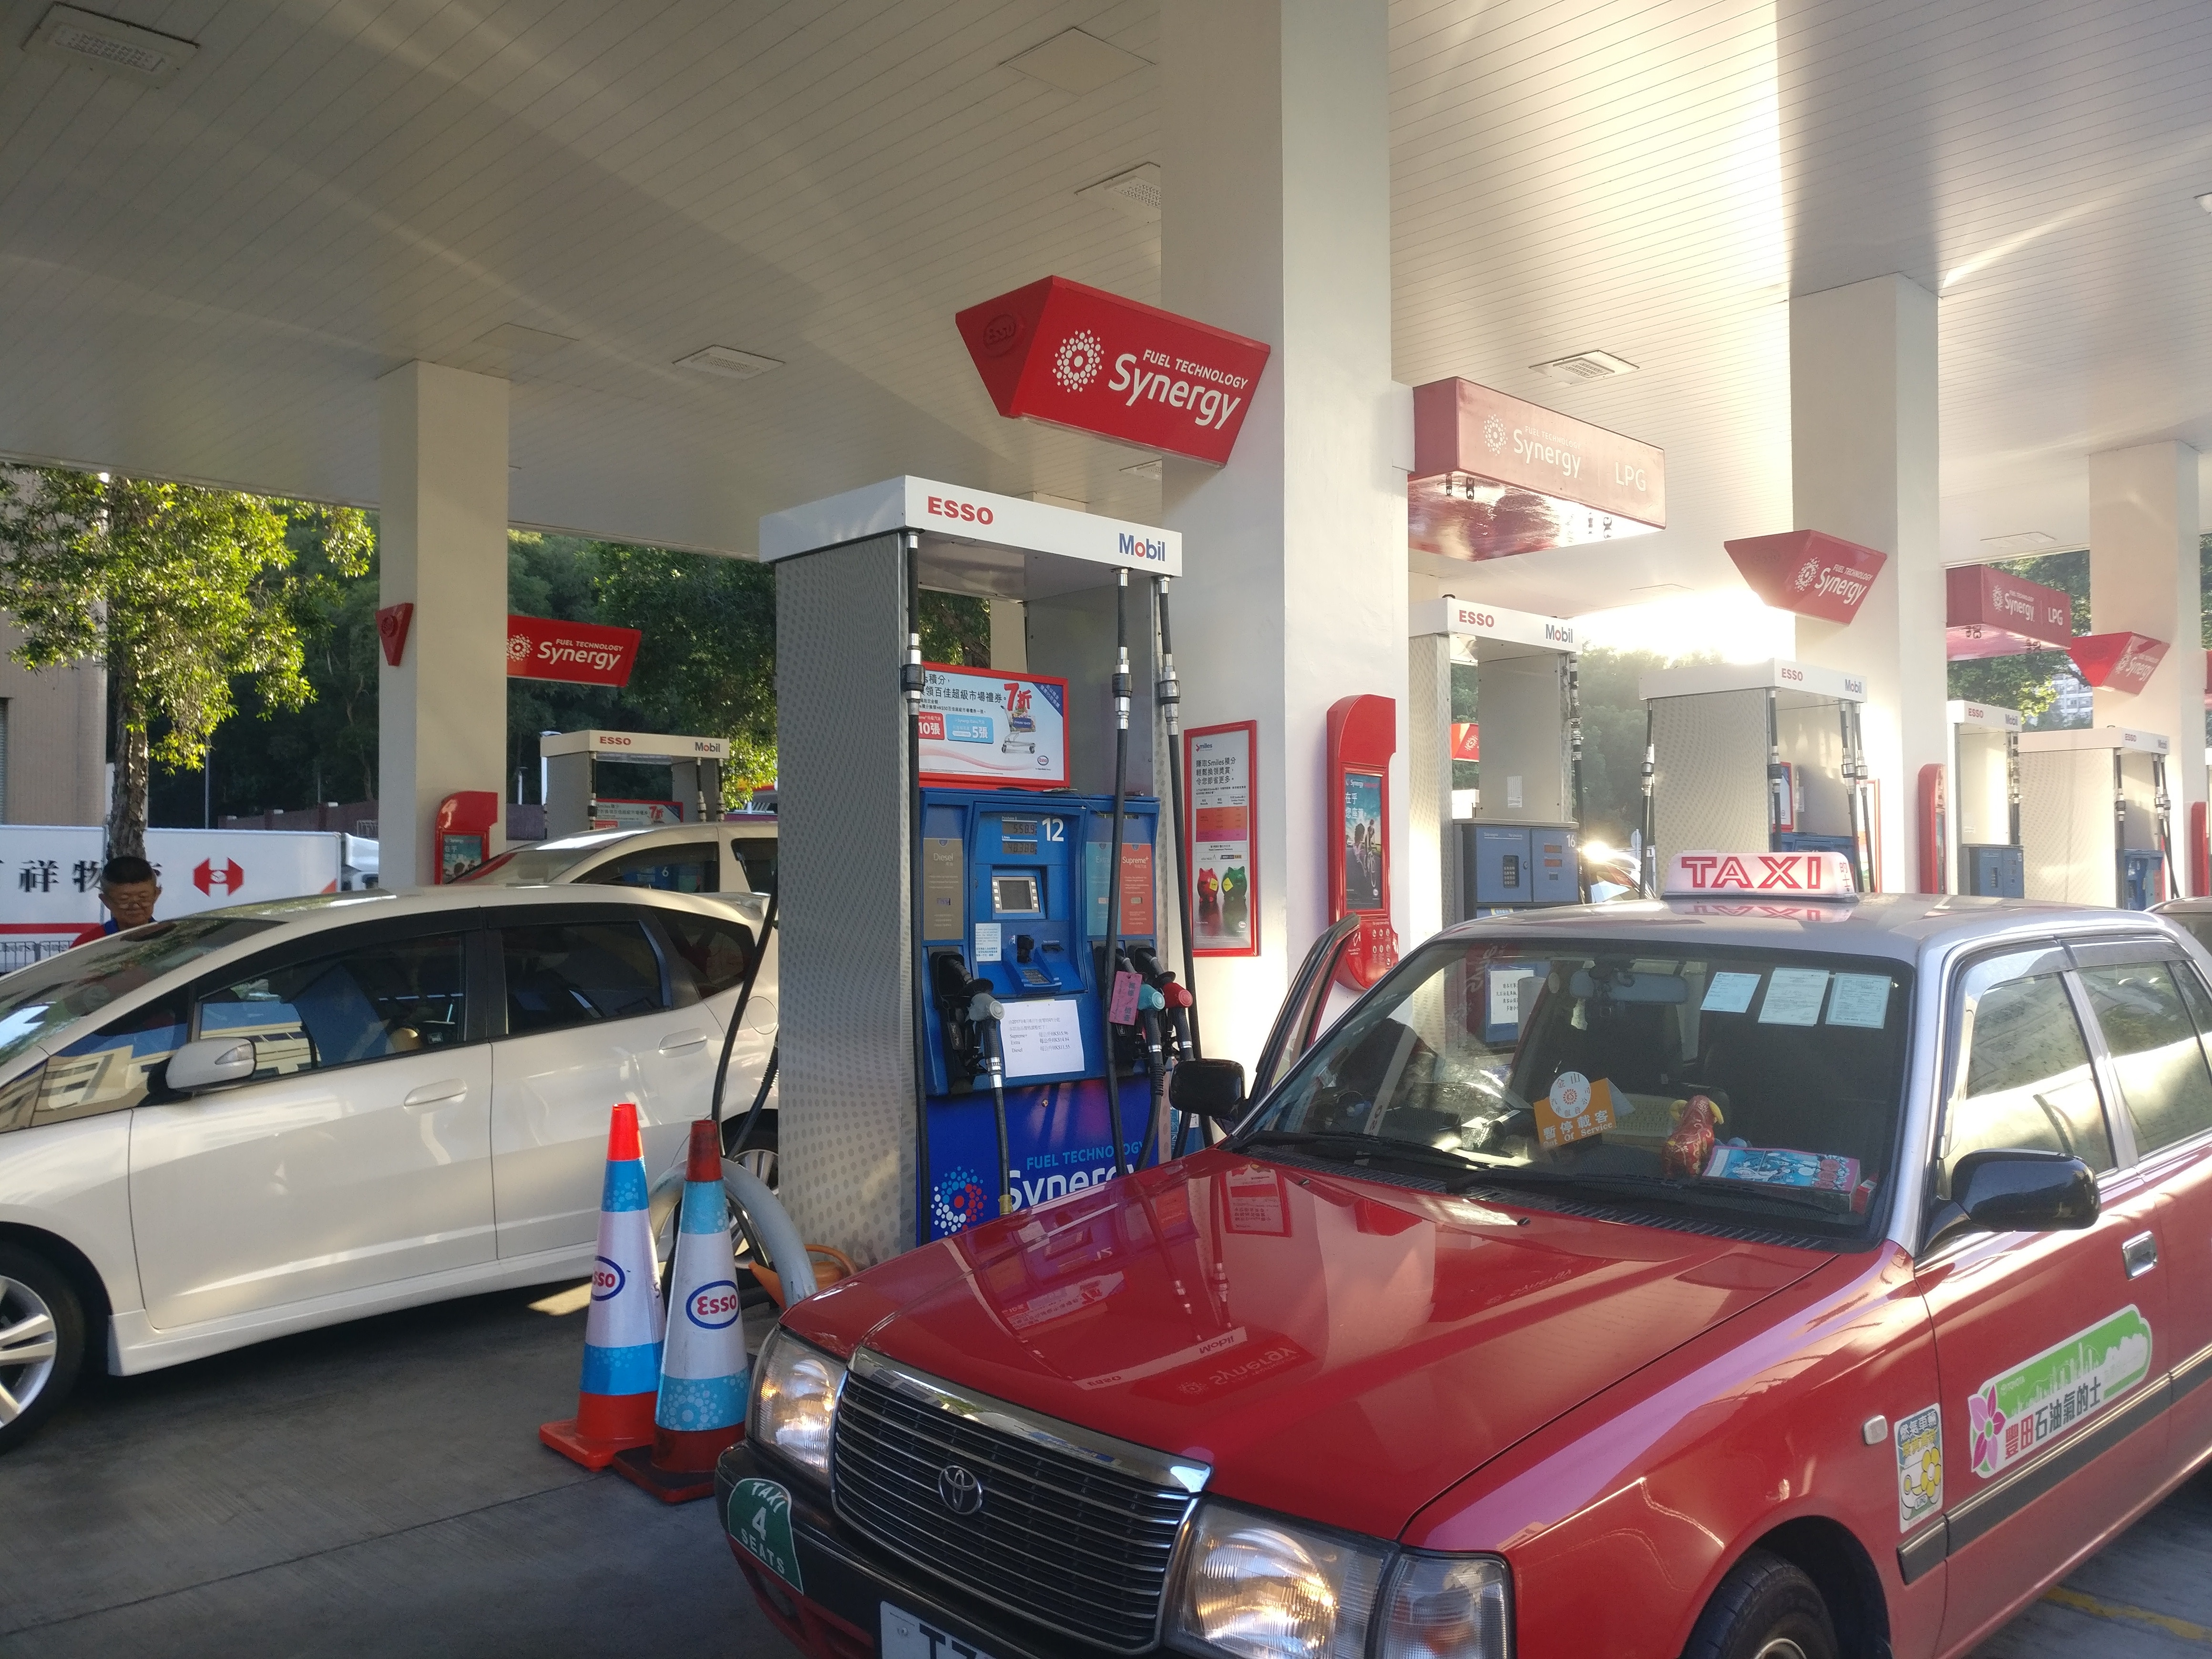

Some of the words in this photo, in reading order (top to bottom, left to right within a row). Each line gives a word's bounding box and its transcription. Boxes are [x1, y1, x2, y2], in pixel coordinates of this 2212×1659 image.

[1143, 349, 1171, 370] FUEL
[1175, 358, 1248, 389] TECHNOLOGY
[1108, 353, 1241, 430] Synergy
[1525, 425, 1540, 437] FUEL
[1541, 431, 1581, 450] TECHNOLOGY
[1514, 429, 1581, 479] Synergy
[1615, 461, 1647, 492] LPG
[928, 496, 993, 525] ESSO
[1119, 533, 1165, 562] Mobil
[1814, 567, 1867, 605] Synergy
[2005, 593, 2034, 621] Synergy
[2048, 607, 2063, 625] LPG
[1459, 609, 1494, 628] ESSO
[1546, 624, 1573, 643] Mobil
[537, 641, 621, 671] Synergy
[575, 640, 624, 652] TECHNOLOGY
[1782, 668, 1803, 681] ESSO
[1845, 679, 1862, 694] Mobil
[922, 686, 1006, 703] 領百佳超級市場禮券。
[1004, 683, 1032, 711] 7折
[1968, 708, 1984, 718] ESSO
[600, 736, 631, 746] ESSO
[695, 742, 720, 752] Mobil
[972, 726, 988, 738] 5張
[1042, 818, 1064, 841] 12
[1567, 835, 1576, 847] 16
[933, 853, 953, 861] Diesel
[662, 867, 669, 878] 6
[1681, 857, 1821, 889] TAXI
[1840, 862, 1851, 887] 的士
[1543, 1110, 1608, 1140] 暫停載客
[1564, 1132, 1574, 1141] Of
[1581, 1122, 1613, 1137] Service
[1026, 1154, 1059, 1170] FUEL
[594, 1271, 615, 1288] sso
[752, 1482, 785, 1513] TAXI
[752, 1506, 767, 1542] 4
[741, 1529, 785, 1574] SEATS
